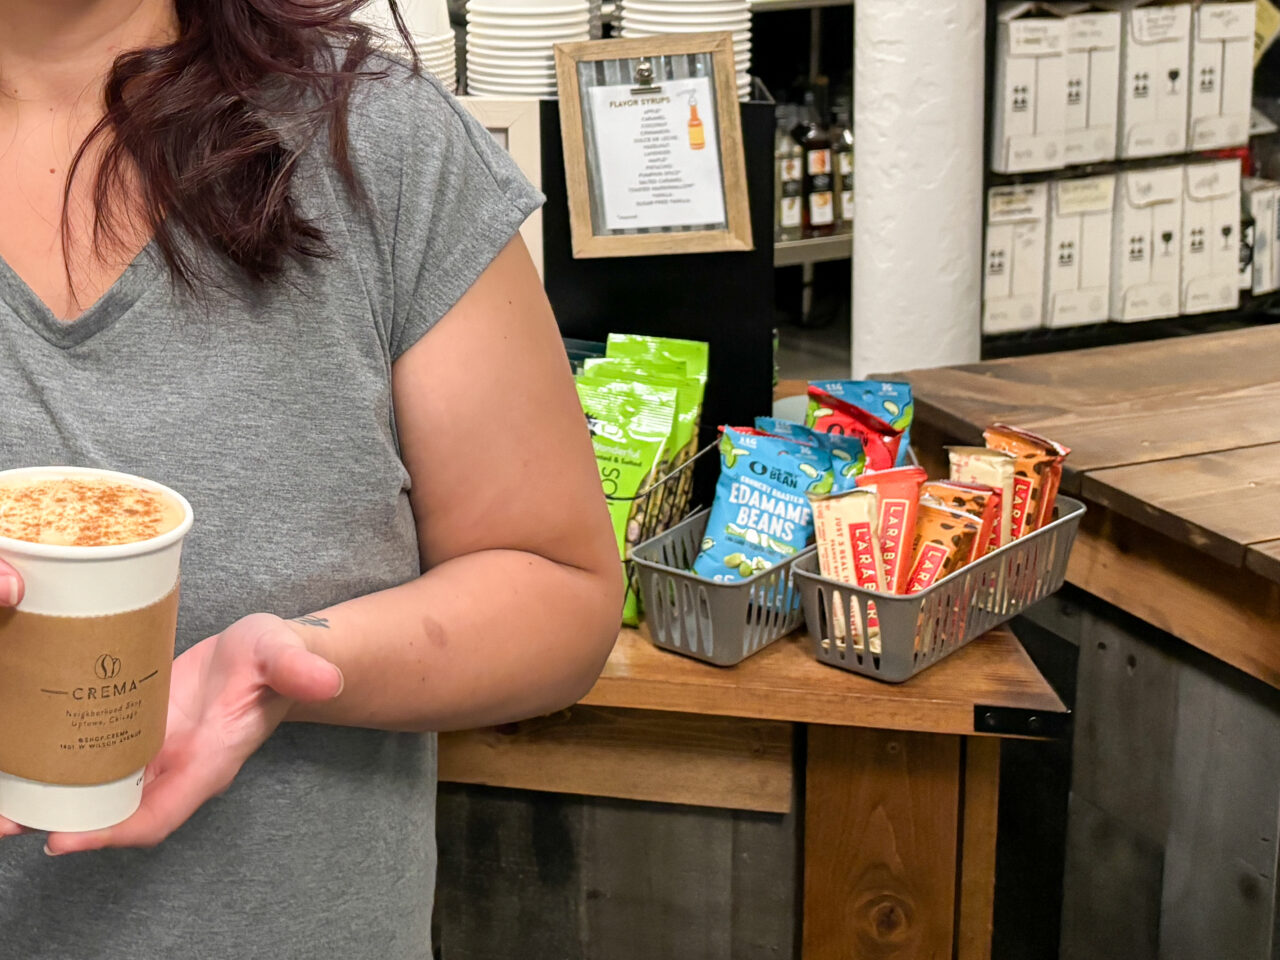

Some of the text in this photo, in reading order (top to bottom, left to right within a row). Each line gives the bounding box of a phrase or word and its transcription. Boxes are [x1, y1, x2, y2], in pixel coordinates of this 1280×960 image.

[609, 96, 671, 109] FLAVOR SYRUPS
[769, 471, 798, 489] BEAN
[728, 482, 812, 526] EDAMAME
[736, 505, 795, 541] BEANS
[72, 679, 137, 700] CREMA
[90, 741, 117, 749] WILSON
